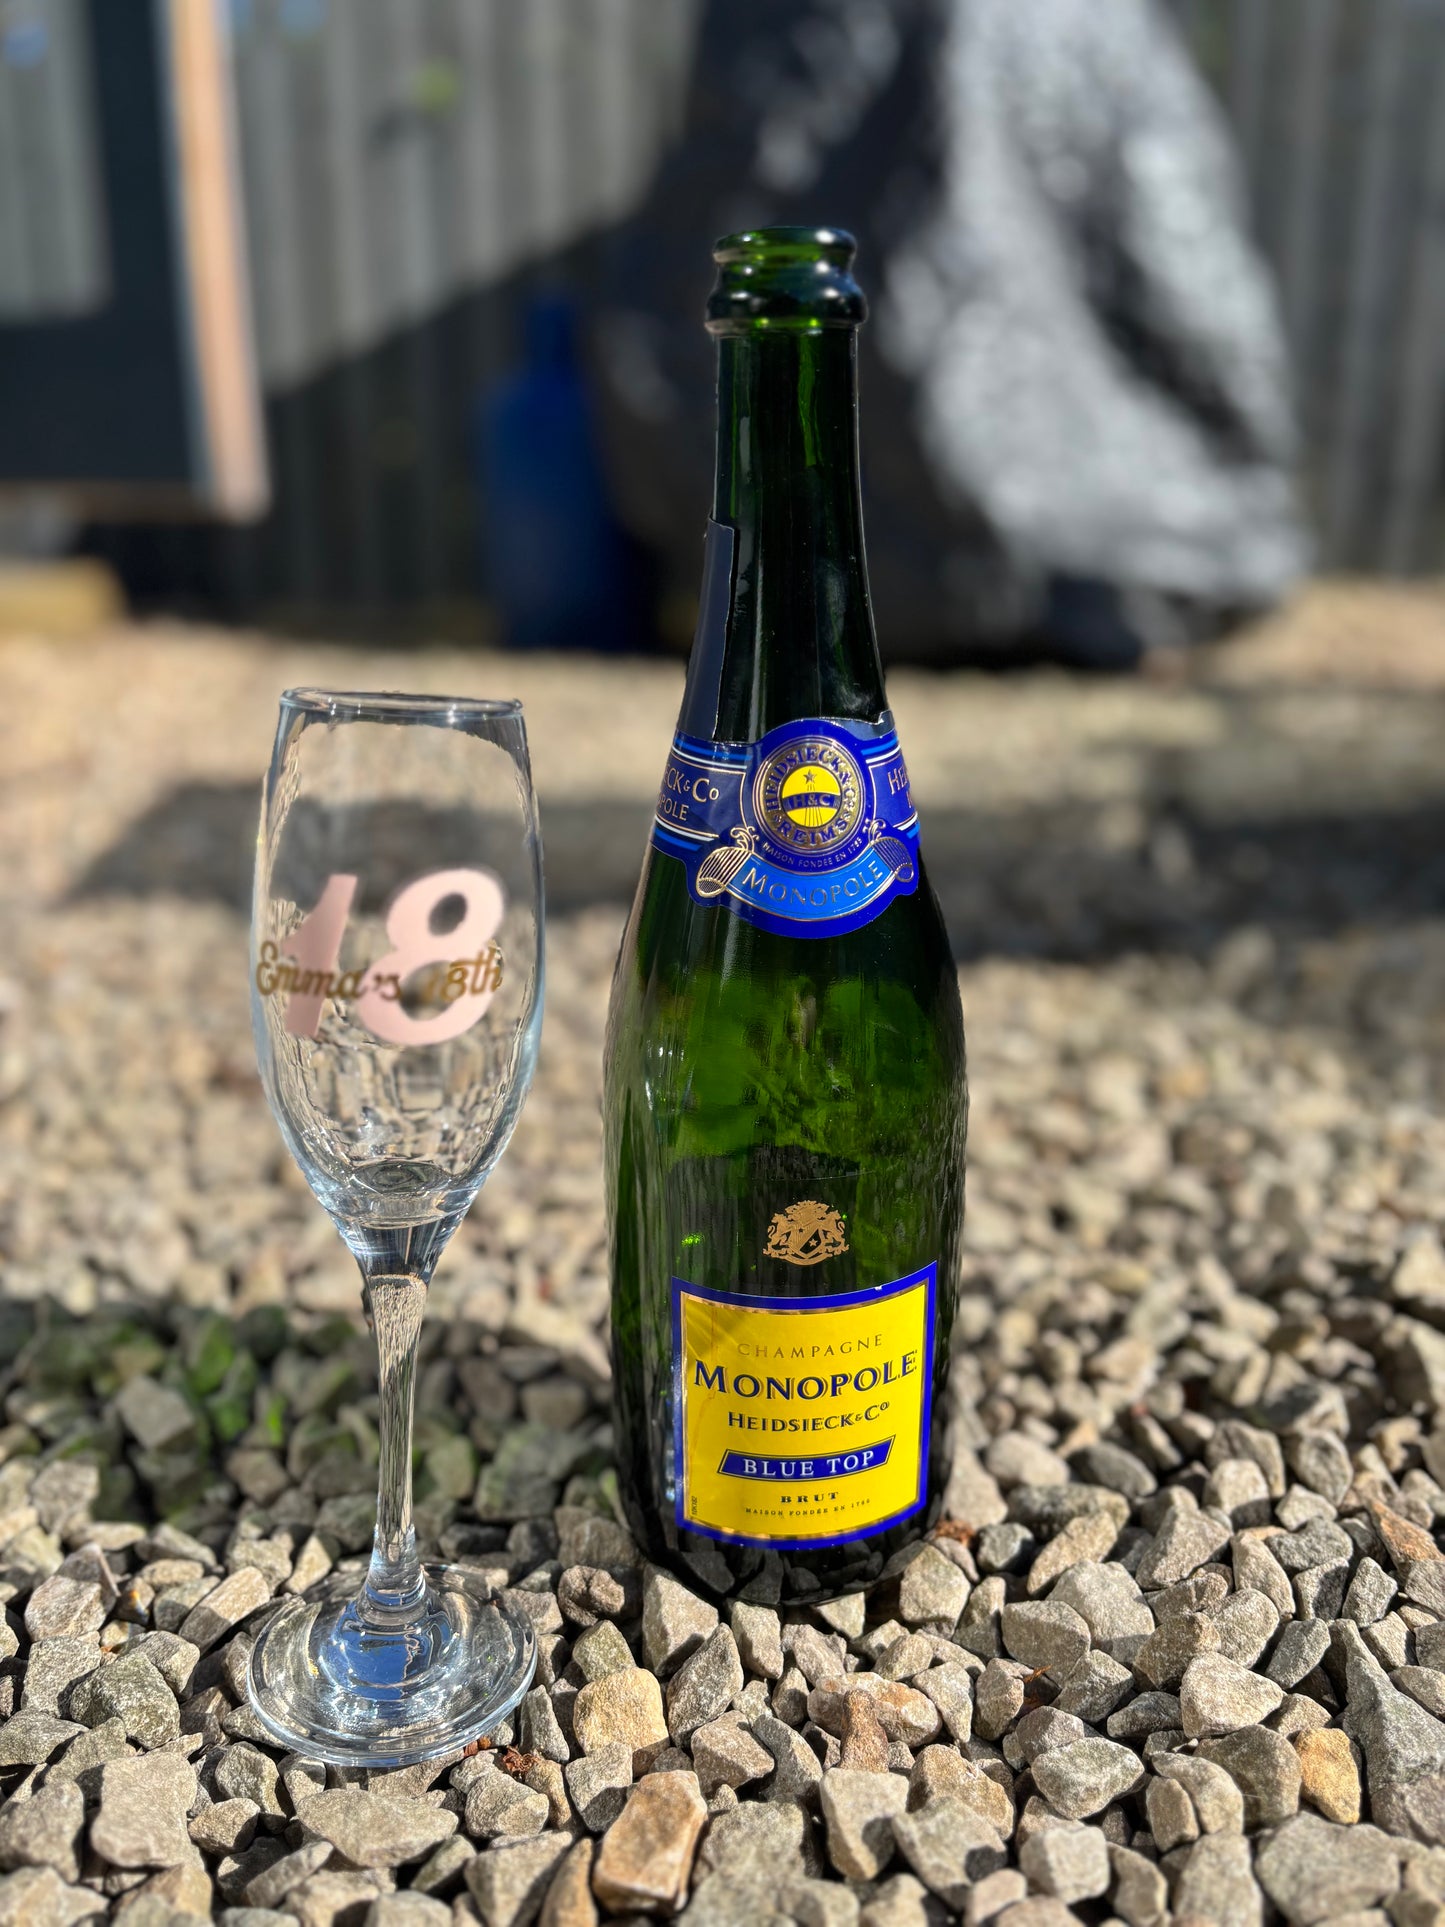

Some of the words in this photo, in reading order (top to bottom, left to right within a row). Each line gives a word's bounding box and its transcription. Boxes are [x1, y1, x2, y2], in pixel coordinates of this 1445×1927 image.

[778, 819, 848, 844] REIMS
[762, 841, 794, 865] MAISON
[835, 852, 847, 863] EN
[742, 867, 883, 907] MONOPOLE
[281, 867, 504, 1046] 18
[738, 1334, 882, 1359] CHAMPAGNE
[693, 1350, 918, 1401] MONOPOLE
[743, 1458, 815, 1477] BLUE
[826, 1450, 875, 1474] TOP
[781, 1491, 839, 1503] BRUT
[745, 1507, 783, 1516] MAISON
